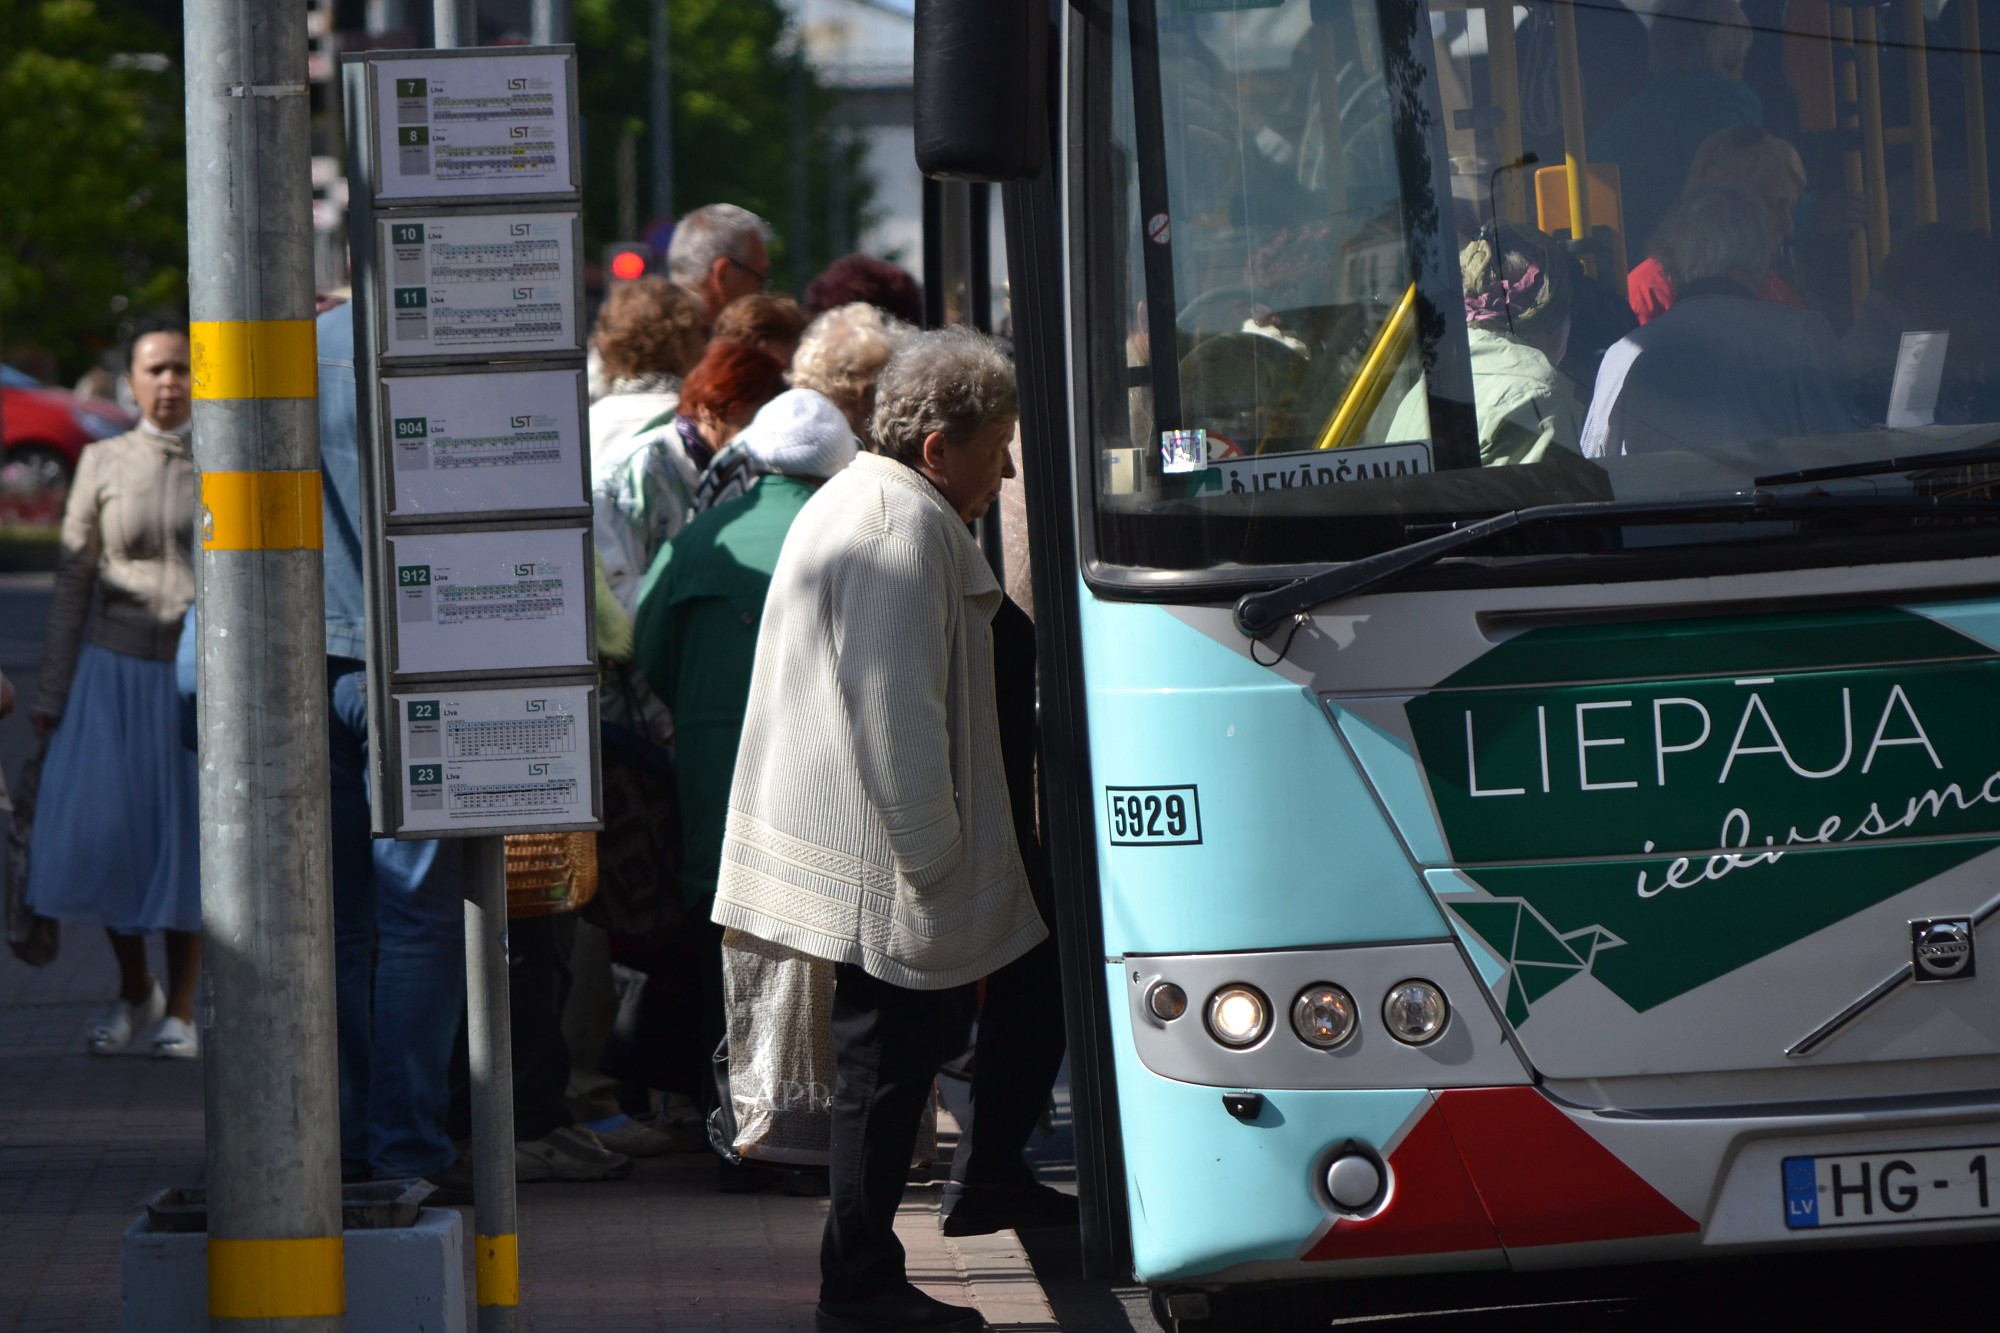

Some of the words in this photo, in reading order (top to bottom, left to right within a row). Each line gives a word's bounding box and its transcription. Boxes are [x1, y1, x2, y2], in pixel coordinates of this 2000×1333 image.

[407, 81, 416, 94] 7
[507, 78, 528, 90] LST
[409, 130, 418, 142] 8
[509, 126, 530, 139] LST
[400, 227, 417, 240] 10
[510, 223, 532, 236] LST
[403, 291, 418, 304] 11
[512, 287, 534, 300] LST
[399, 421, 424, 435] 904
[511, 415, 532, 428] LST
[402, 569, 427, 582] 912
[514, 563, 536, 576] LST
[415, 704, 432, 718] 22
[526, 699, 547, 712] LST
[1465, 677, 1944, 797] LIEPĀJA
[417, 768, 434, 781] 23
[528, 763, 550, 776] LST
[1113, 794, 1187, 837] 5929
[1920, 944, 1968, 955] VOLVO
[1790, 1200, 1814, 1215] LV
